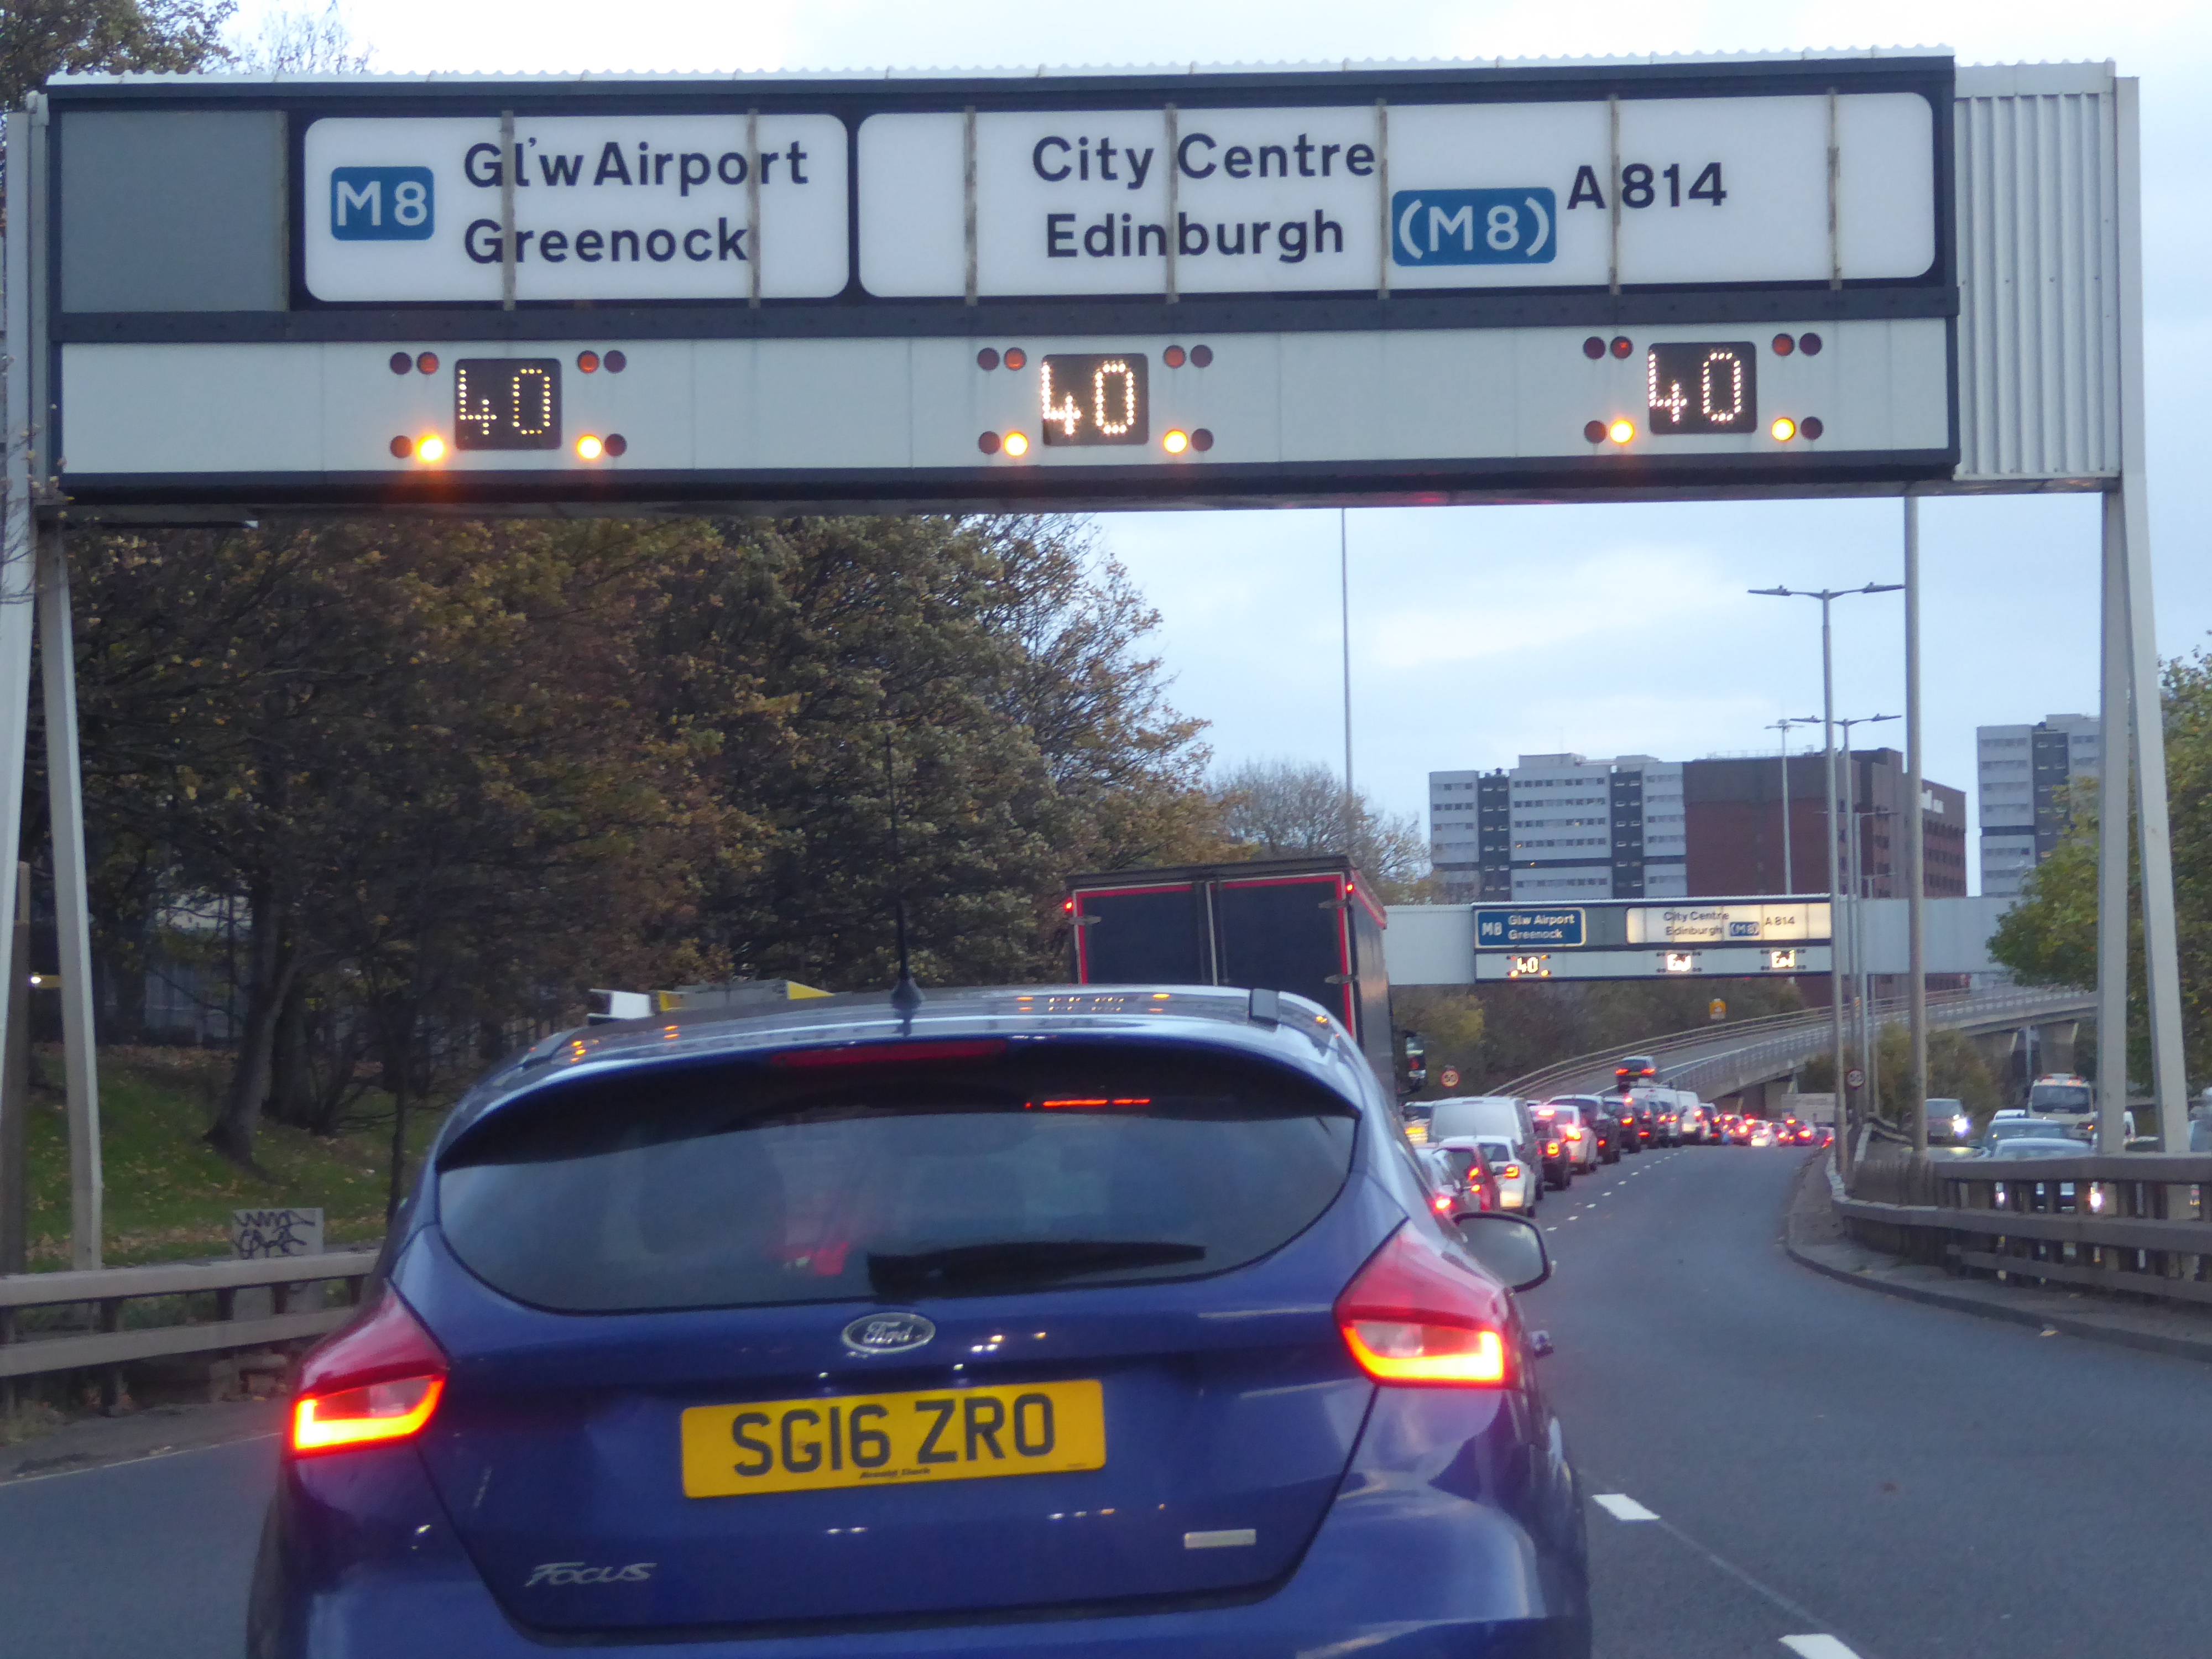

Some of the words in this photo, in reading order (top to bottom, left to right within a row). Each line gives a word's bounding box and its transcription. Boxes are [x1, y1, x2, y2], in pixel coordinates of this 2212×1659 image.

[594, 140, 808, 196] Airport
[1032, 135, 1154, 189] City
[1177, 133, 1375, 179] Centre
[337, 180, 427, 226] M8
[465, 218, 748, 263] Greenock
[1047, 210, 1343, 263] Edinburgh
[1398, 196, 1550, 259] (M8)
[459, 368, 551, 436] 40
[1042, 360, 1134, 436] 40
[1647, 348, 1741, 422] 40
[1481, 922, 1503, 936] M8
[1508, 928, 1563, 940] Greenock
[1533, 914, 1575, 926] Airport
[1663, 911, 1688, 922] City
[1690, 911, 1729, 920] Centre
[1666, 925, 1723, 936] Edinburgh
[1517, 957, 1538, 973] 40
[864, 1321, 914, 1344] Ford
[733, 1402, 891, 1478] SG16
[914, 1393, 1055, 1465] ZRO
